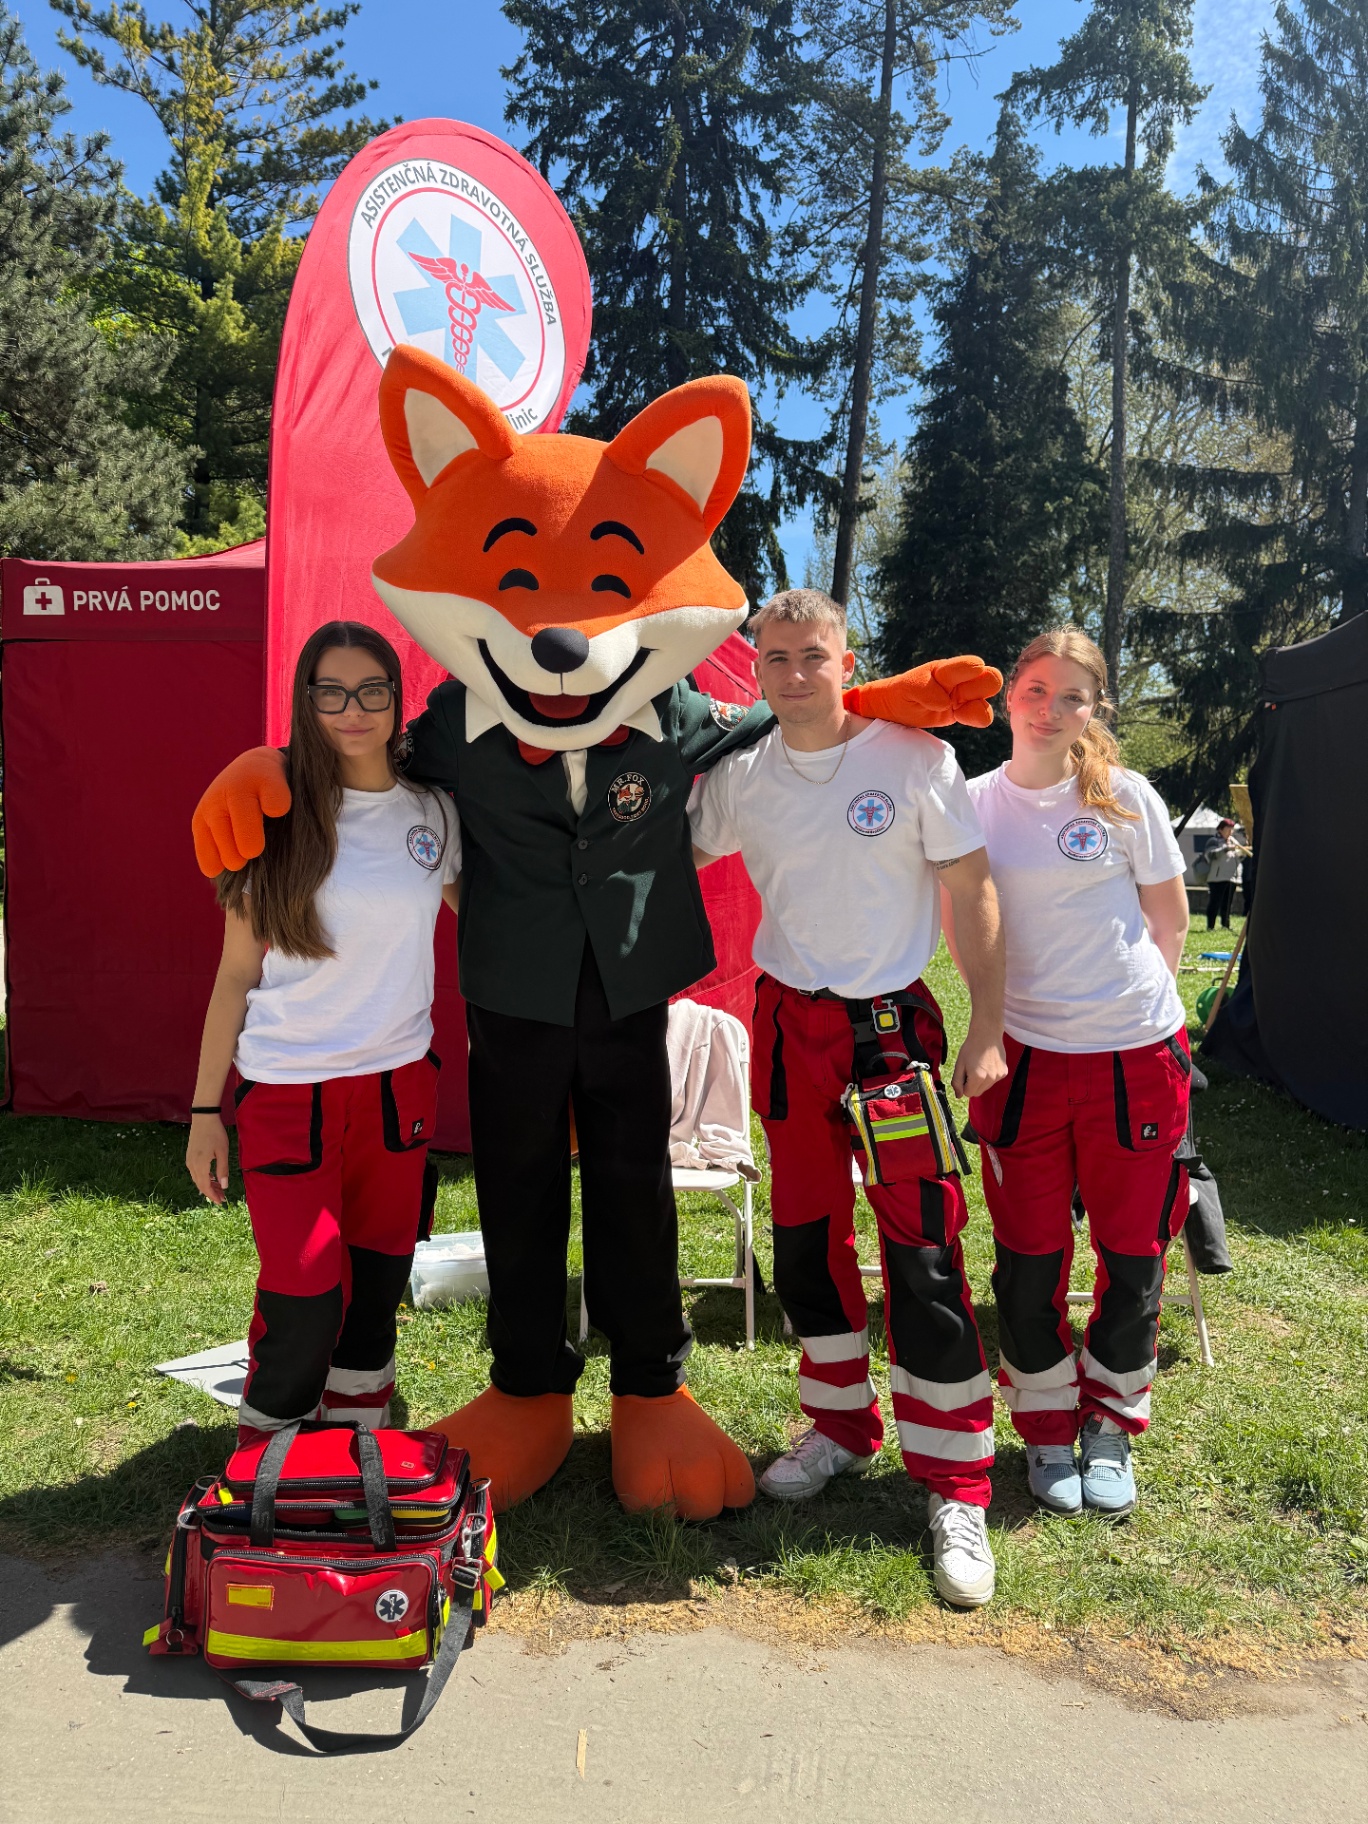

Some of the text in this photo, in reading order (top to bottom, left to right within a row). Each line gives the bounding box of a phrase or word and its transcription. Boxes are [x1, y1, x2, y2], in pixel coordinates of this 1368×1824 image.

[360, 162, 557, 326] ASISTENČNÁ ZDRAVOTNÁ SLUŽBA
[505, 407, 538, 430] linic
[73, 586, 221, 611] PRVÁ POMOC
